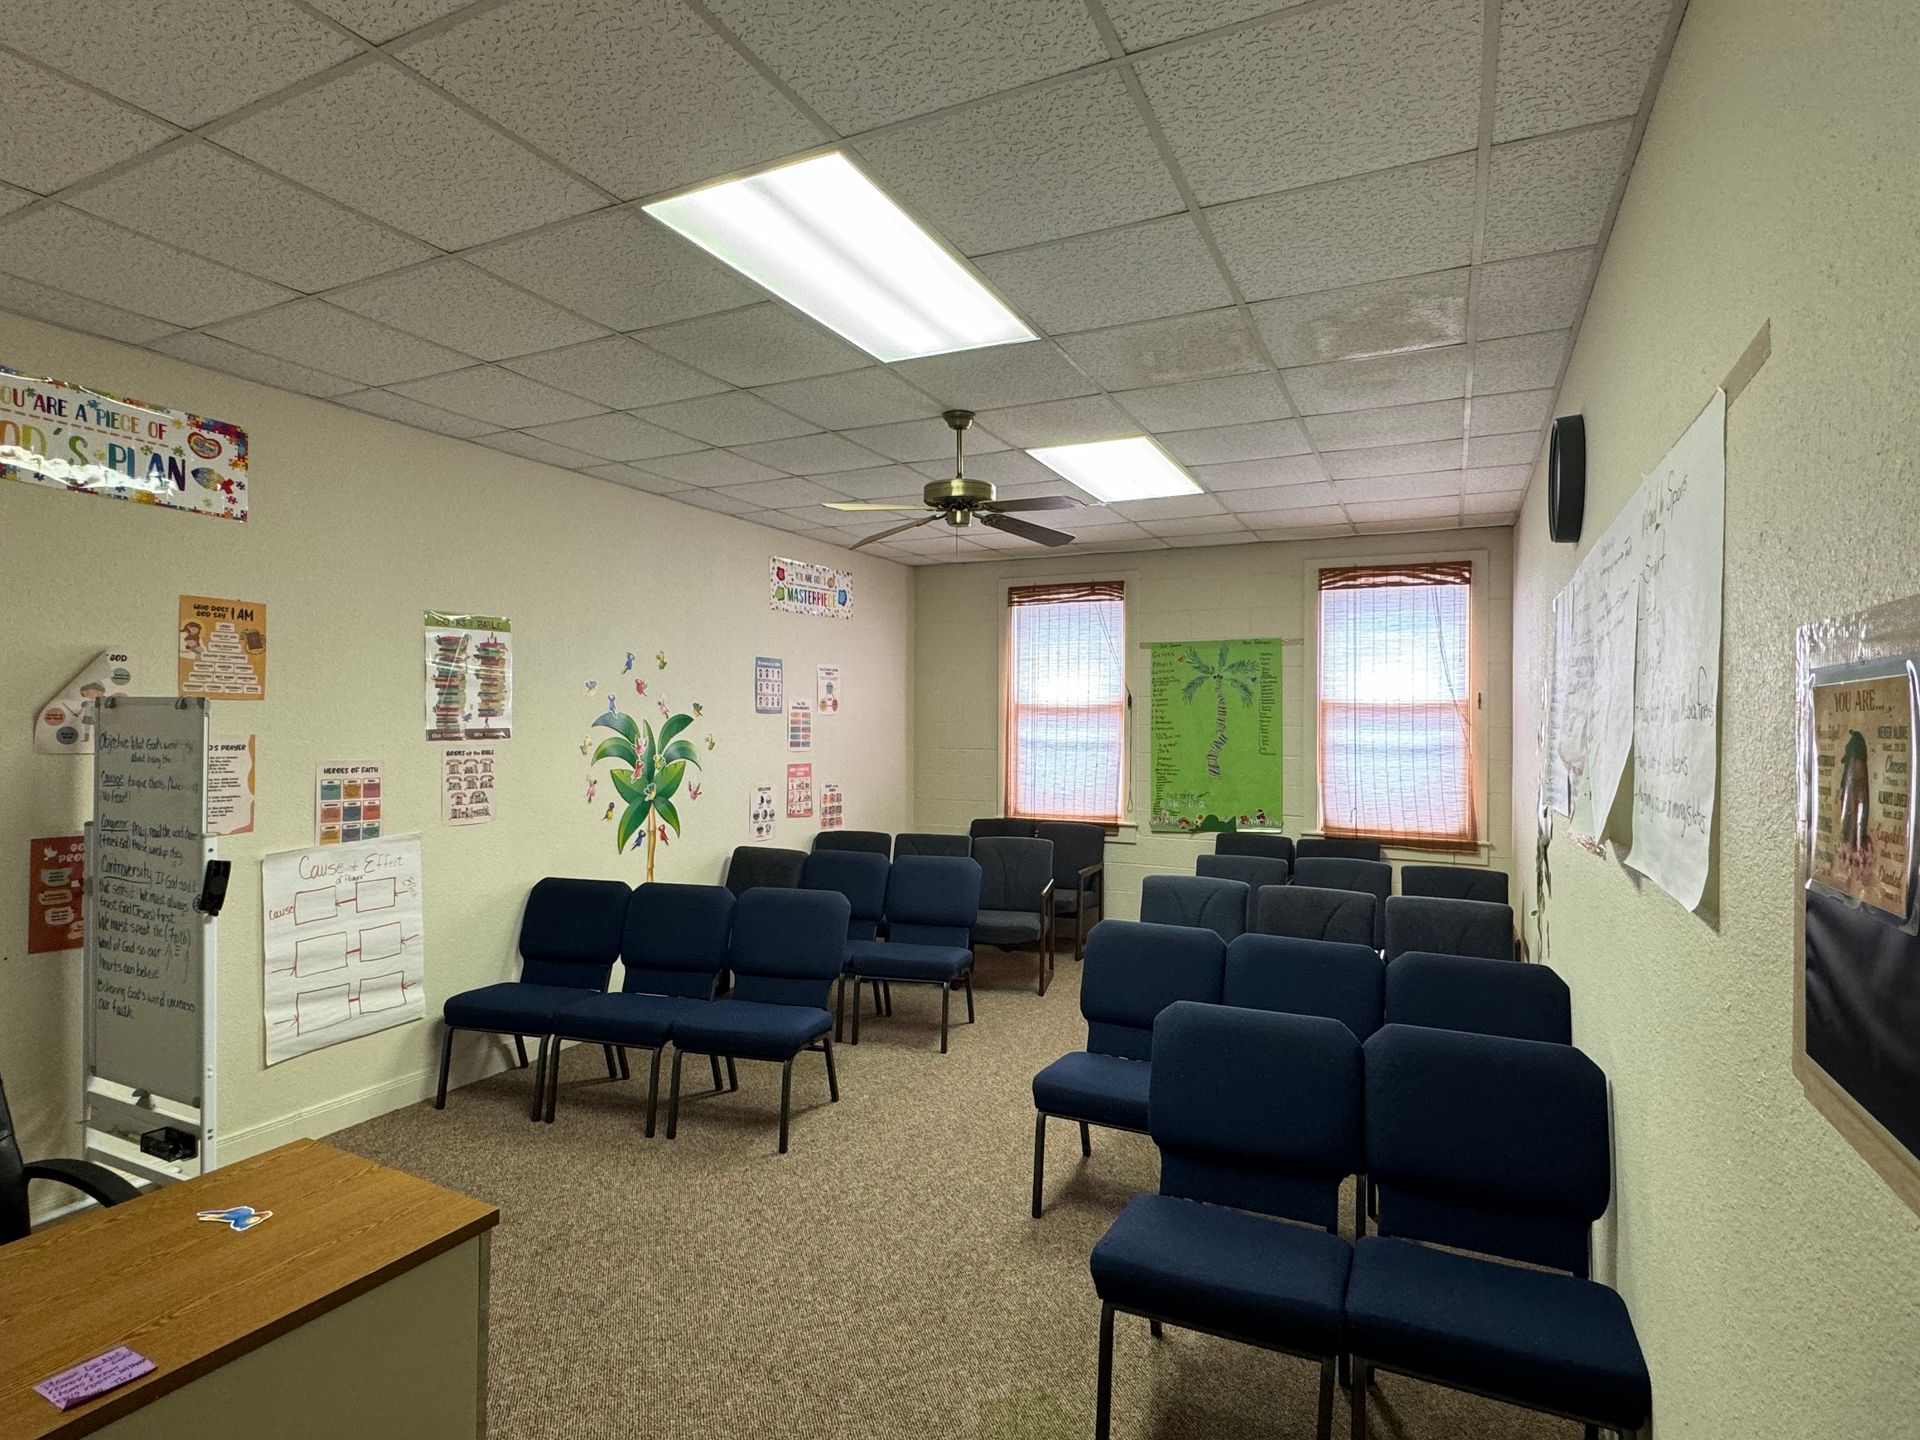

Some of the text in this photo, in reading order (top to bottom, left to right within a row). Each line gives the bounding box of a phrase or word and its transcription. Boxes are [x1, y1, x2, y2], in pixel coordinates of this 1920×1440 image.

[0, 386, 167, 440] OU ARE A PIECE OF
[0, 419, 186, 492] OD'S PLAN
[787, 587, 836, 609] MASTERPIECE
[193, 603, 230, 613] WHO DOES
[230, 607, 254, 621] I AM
[436, 619, 466, 627] BOKS
[109, 654, 128, 662] GOD
[1834, 692, 1851, 712] YOU
[323, 766, 379, 775] HEROES OF FAITH
[299, 855, 344, 880] Cause
[364, 853, 405, 874] Effect
[269, 905, 294, 921] Cause
